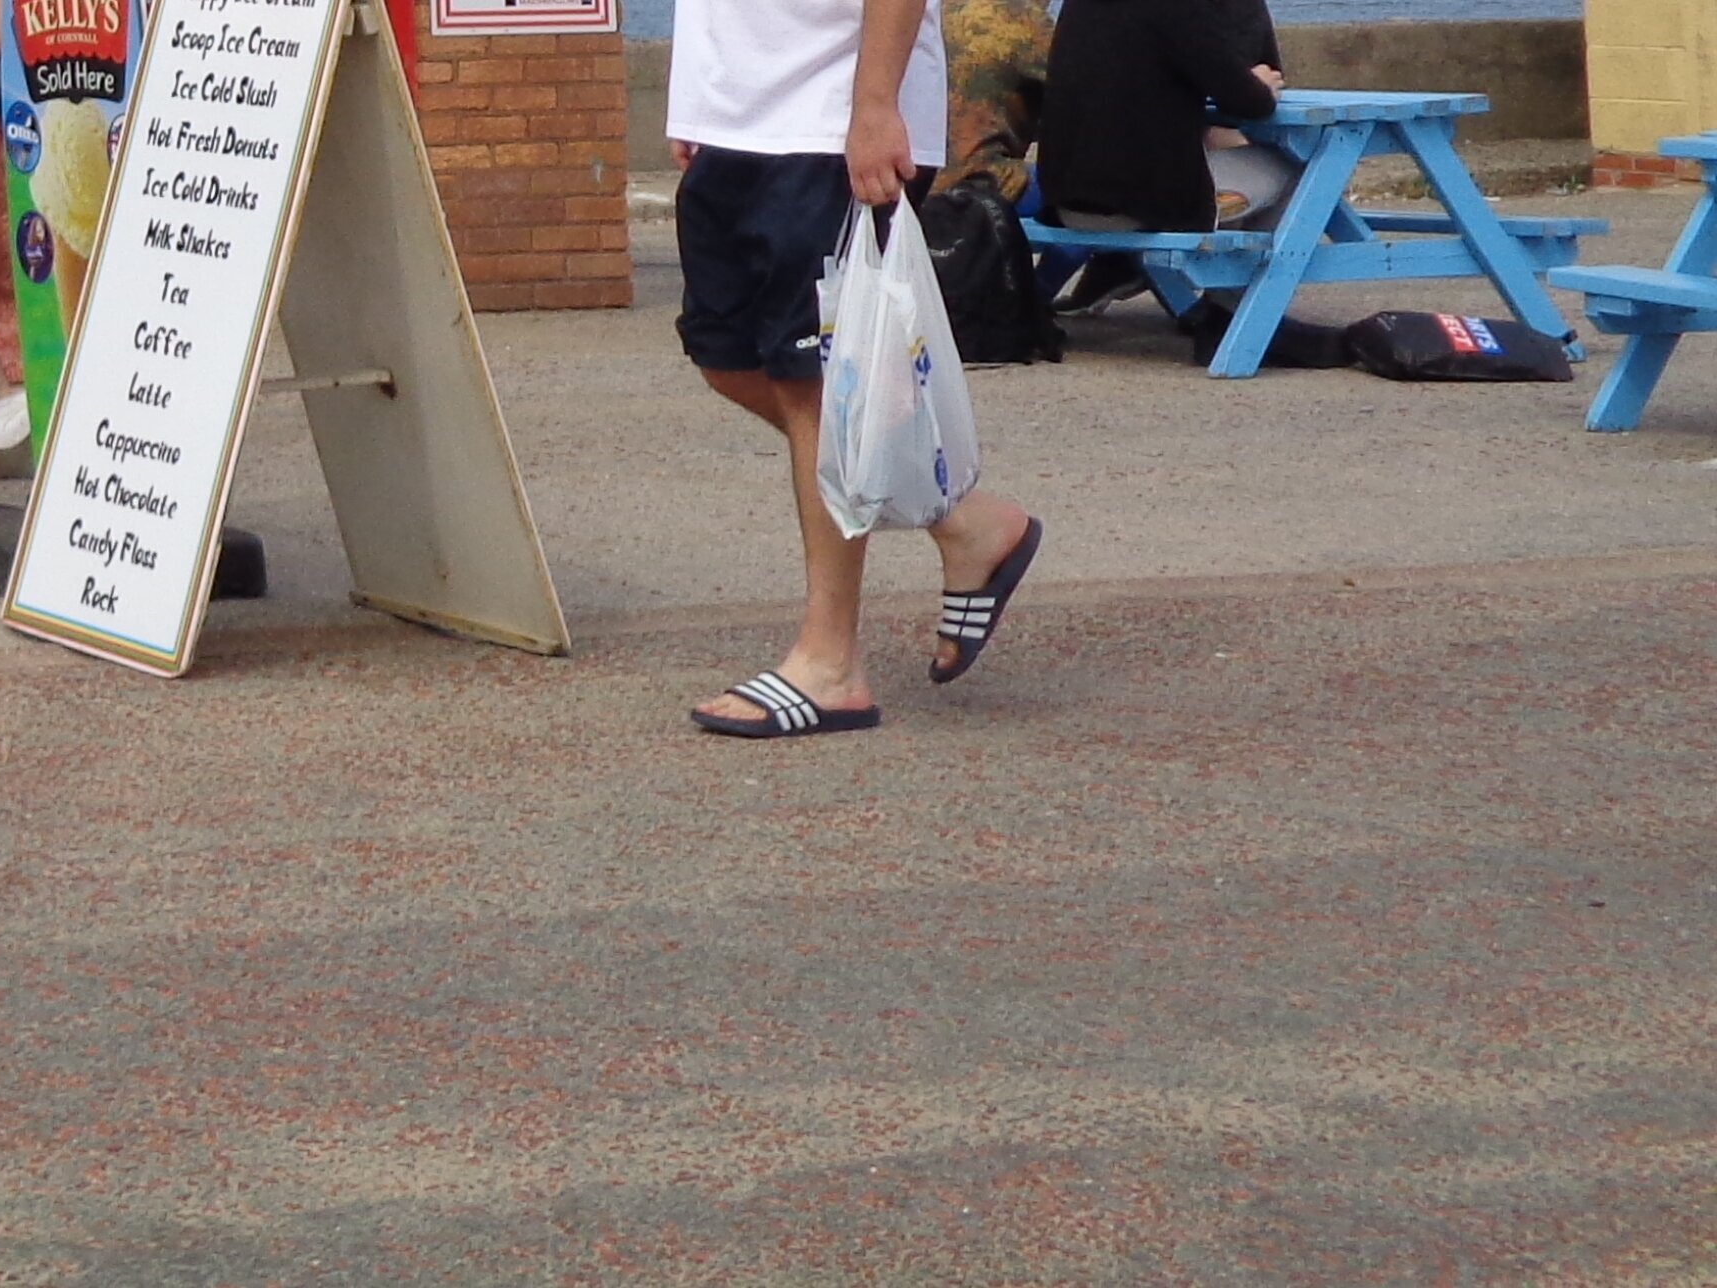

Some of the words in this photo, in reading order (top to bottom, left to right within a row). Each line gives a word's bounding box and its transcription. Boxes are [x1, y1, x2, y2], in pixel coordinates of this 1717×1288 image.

[57, 33, 99, 45] CORNWALL
[171, 20, 215, 60] Scoop
[217, 24, 244, 54] Ice
[248, 26, 302, 58] Cream
[37, 61, 73, 95] Sold
[75, 60, 115, 93] Here
[171, 70, 197, 100] Ice
[201, 73, 236, 103] Cold
[236, 76, 277, 108] Slush
[147, 117, 173, 148] Hot
[176, 121, 218, 153] Fresh
[222, 126, 279, 160] Donuts
[143, 168, 168, 198] Ice
[172, 171, 206, 204] Cold
[206, 175, 258, 211] Drinks
[144, 218, 175, 251] Milk
[177, 223, 231, 259] Shakes
[161, 273, 190, 306] Tea
[134, 321, 192, 360] Coffee
[128, 372, 172, 409] Latte
[96, 418, 181, 465] Cappuccino
[74, 465, 100, 499] Hot
[104, 474, 178, 519] Chocolate
[69, 518, 118, 568] Candy
[120, 532, 158, 570] Floss
[80, 576, 119, 614] Rock
